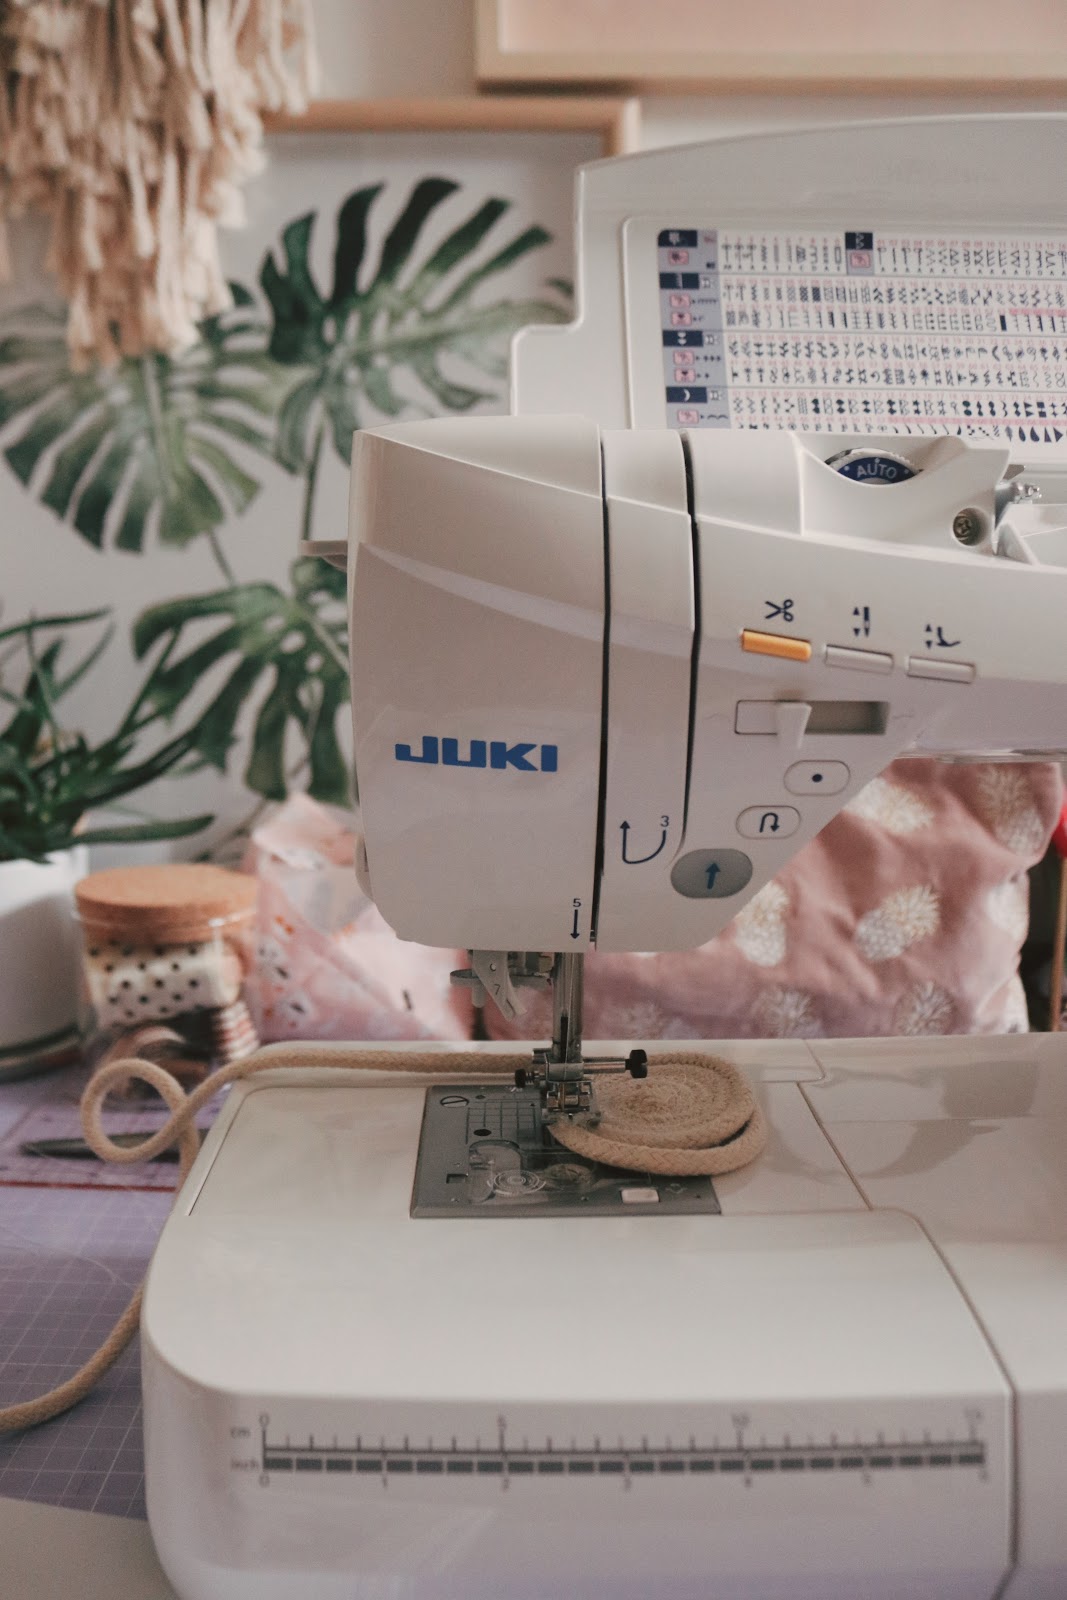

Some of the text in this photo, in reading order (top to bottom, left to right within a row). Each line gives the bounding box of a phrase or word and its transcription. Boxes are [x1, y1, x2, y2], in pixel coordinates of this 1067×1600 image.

[856, 462, 898, 479] AUTO
[395, 735, 558, 772] JUKI
[659, 815, 670, 828] 3
[572, 897, 582, 908] 5
